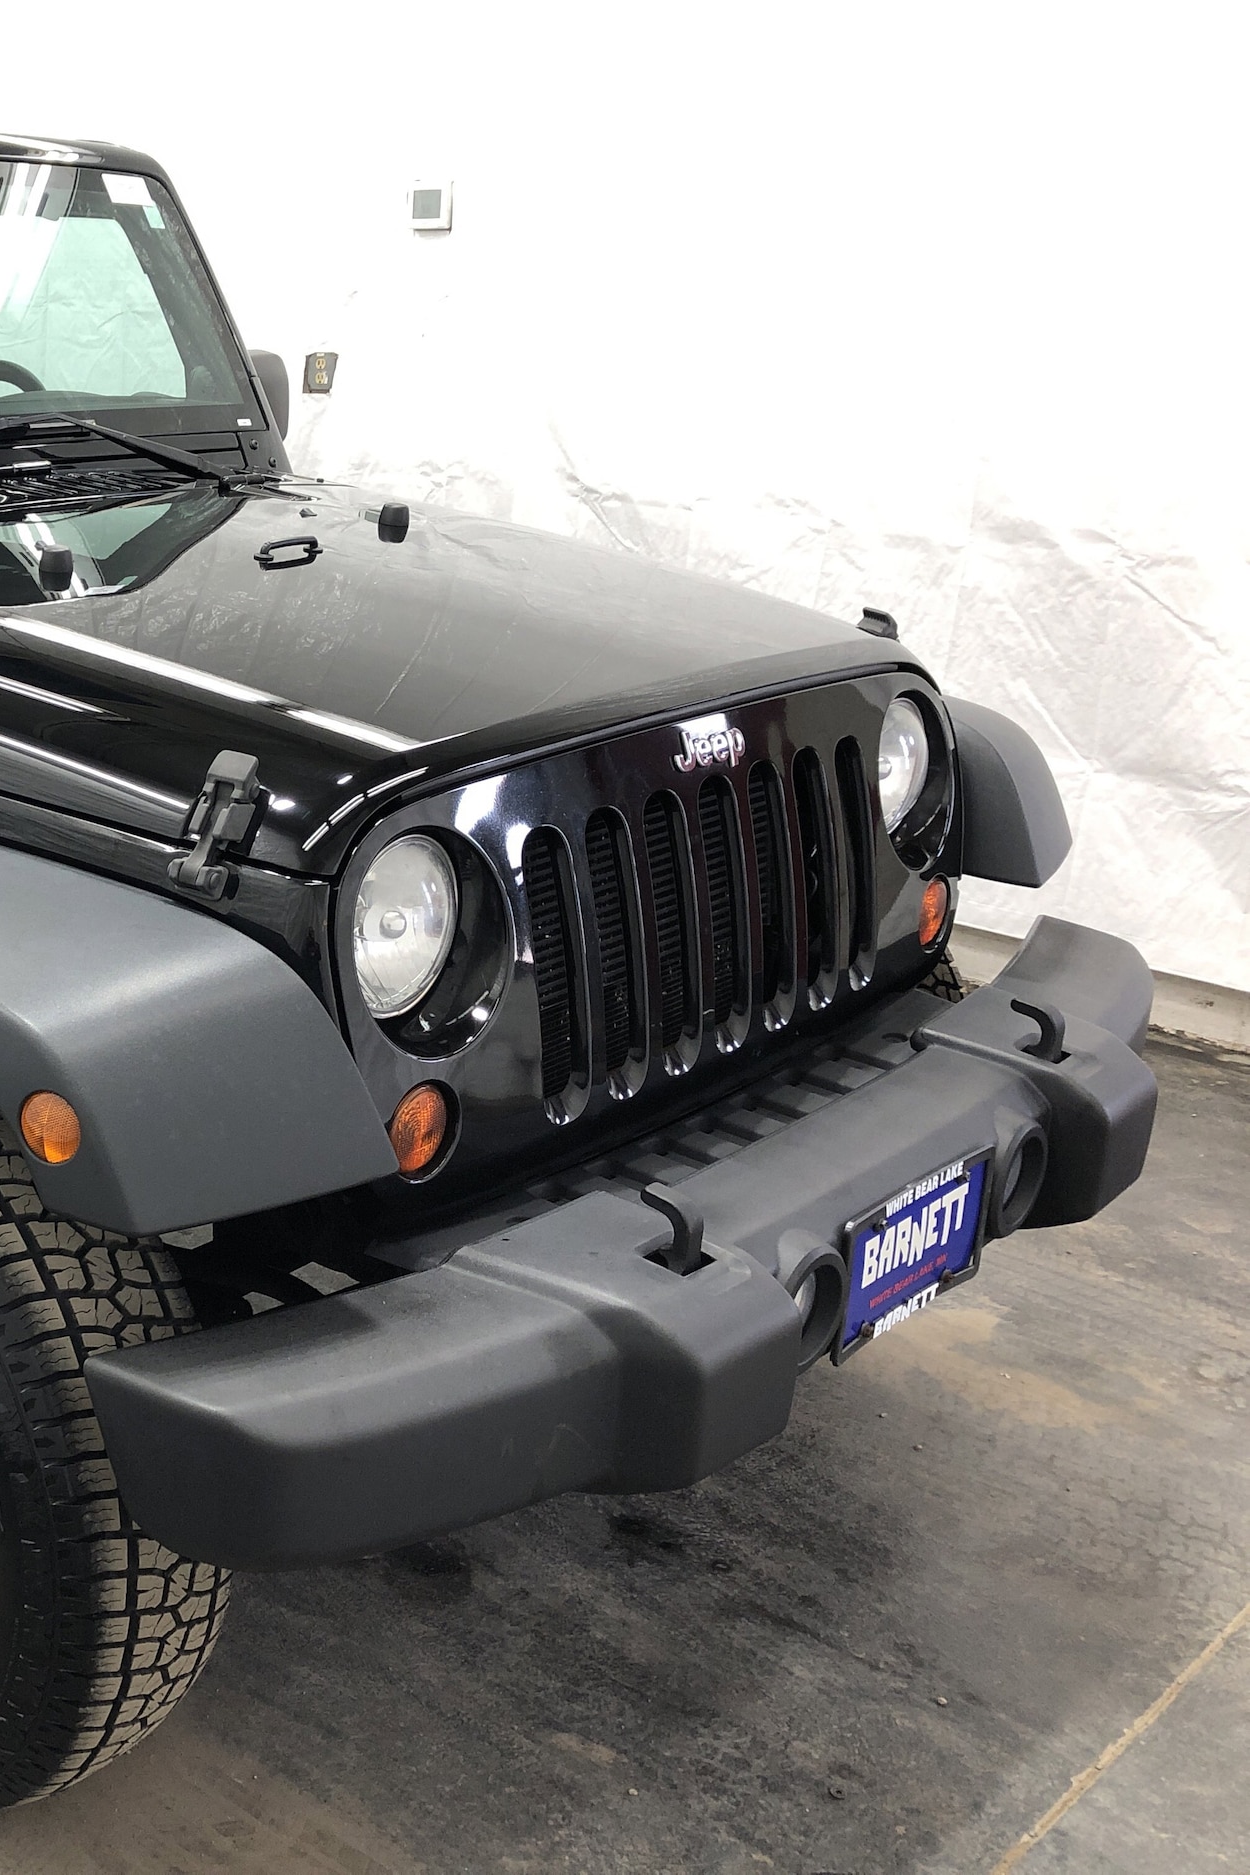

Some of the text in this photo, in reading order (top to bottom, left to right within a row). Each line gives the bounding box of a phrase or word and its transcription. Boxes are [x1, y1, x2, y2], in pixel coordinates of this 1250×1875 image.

[674, 727, 746, 772] Jeep
[886, 1161, 965, 1218] WHITE BEAR LAKE
[861, 1182, 970, 1289] BARNETT
[873, 1282, 940, 1339] BARNETT
